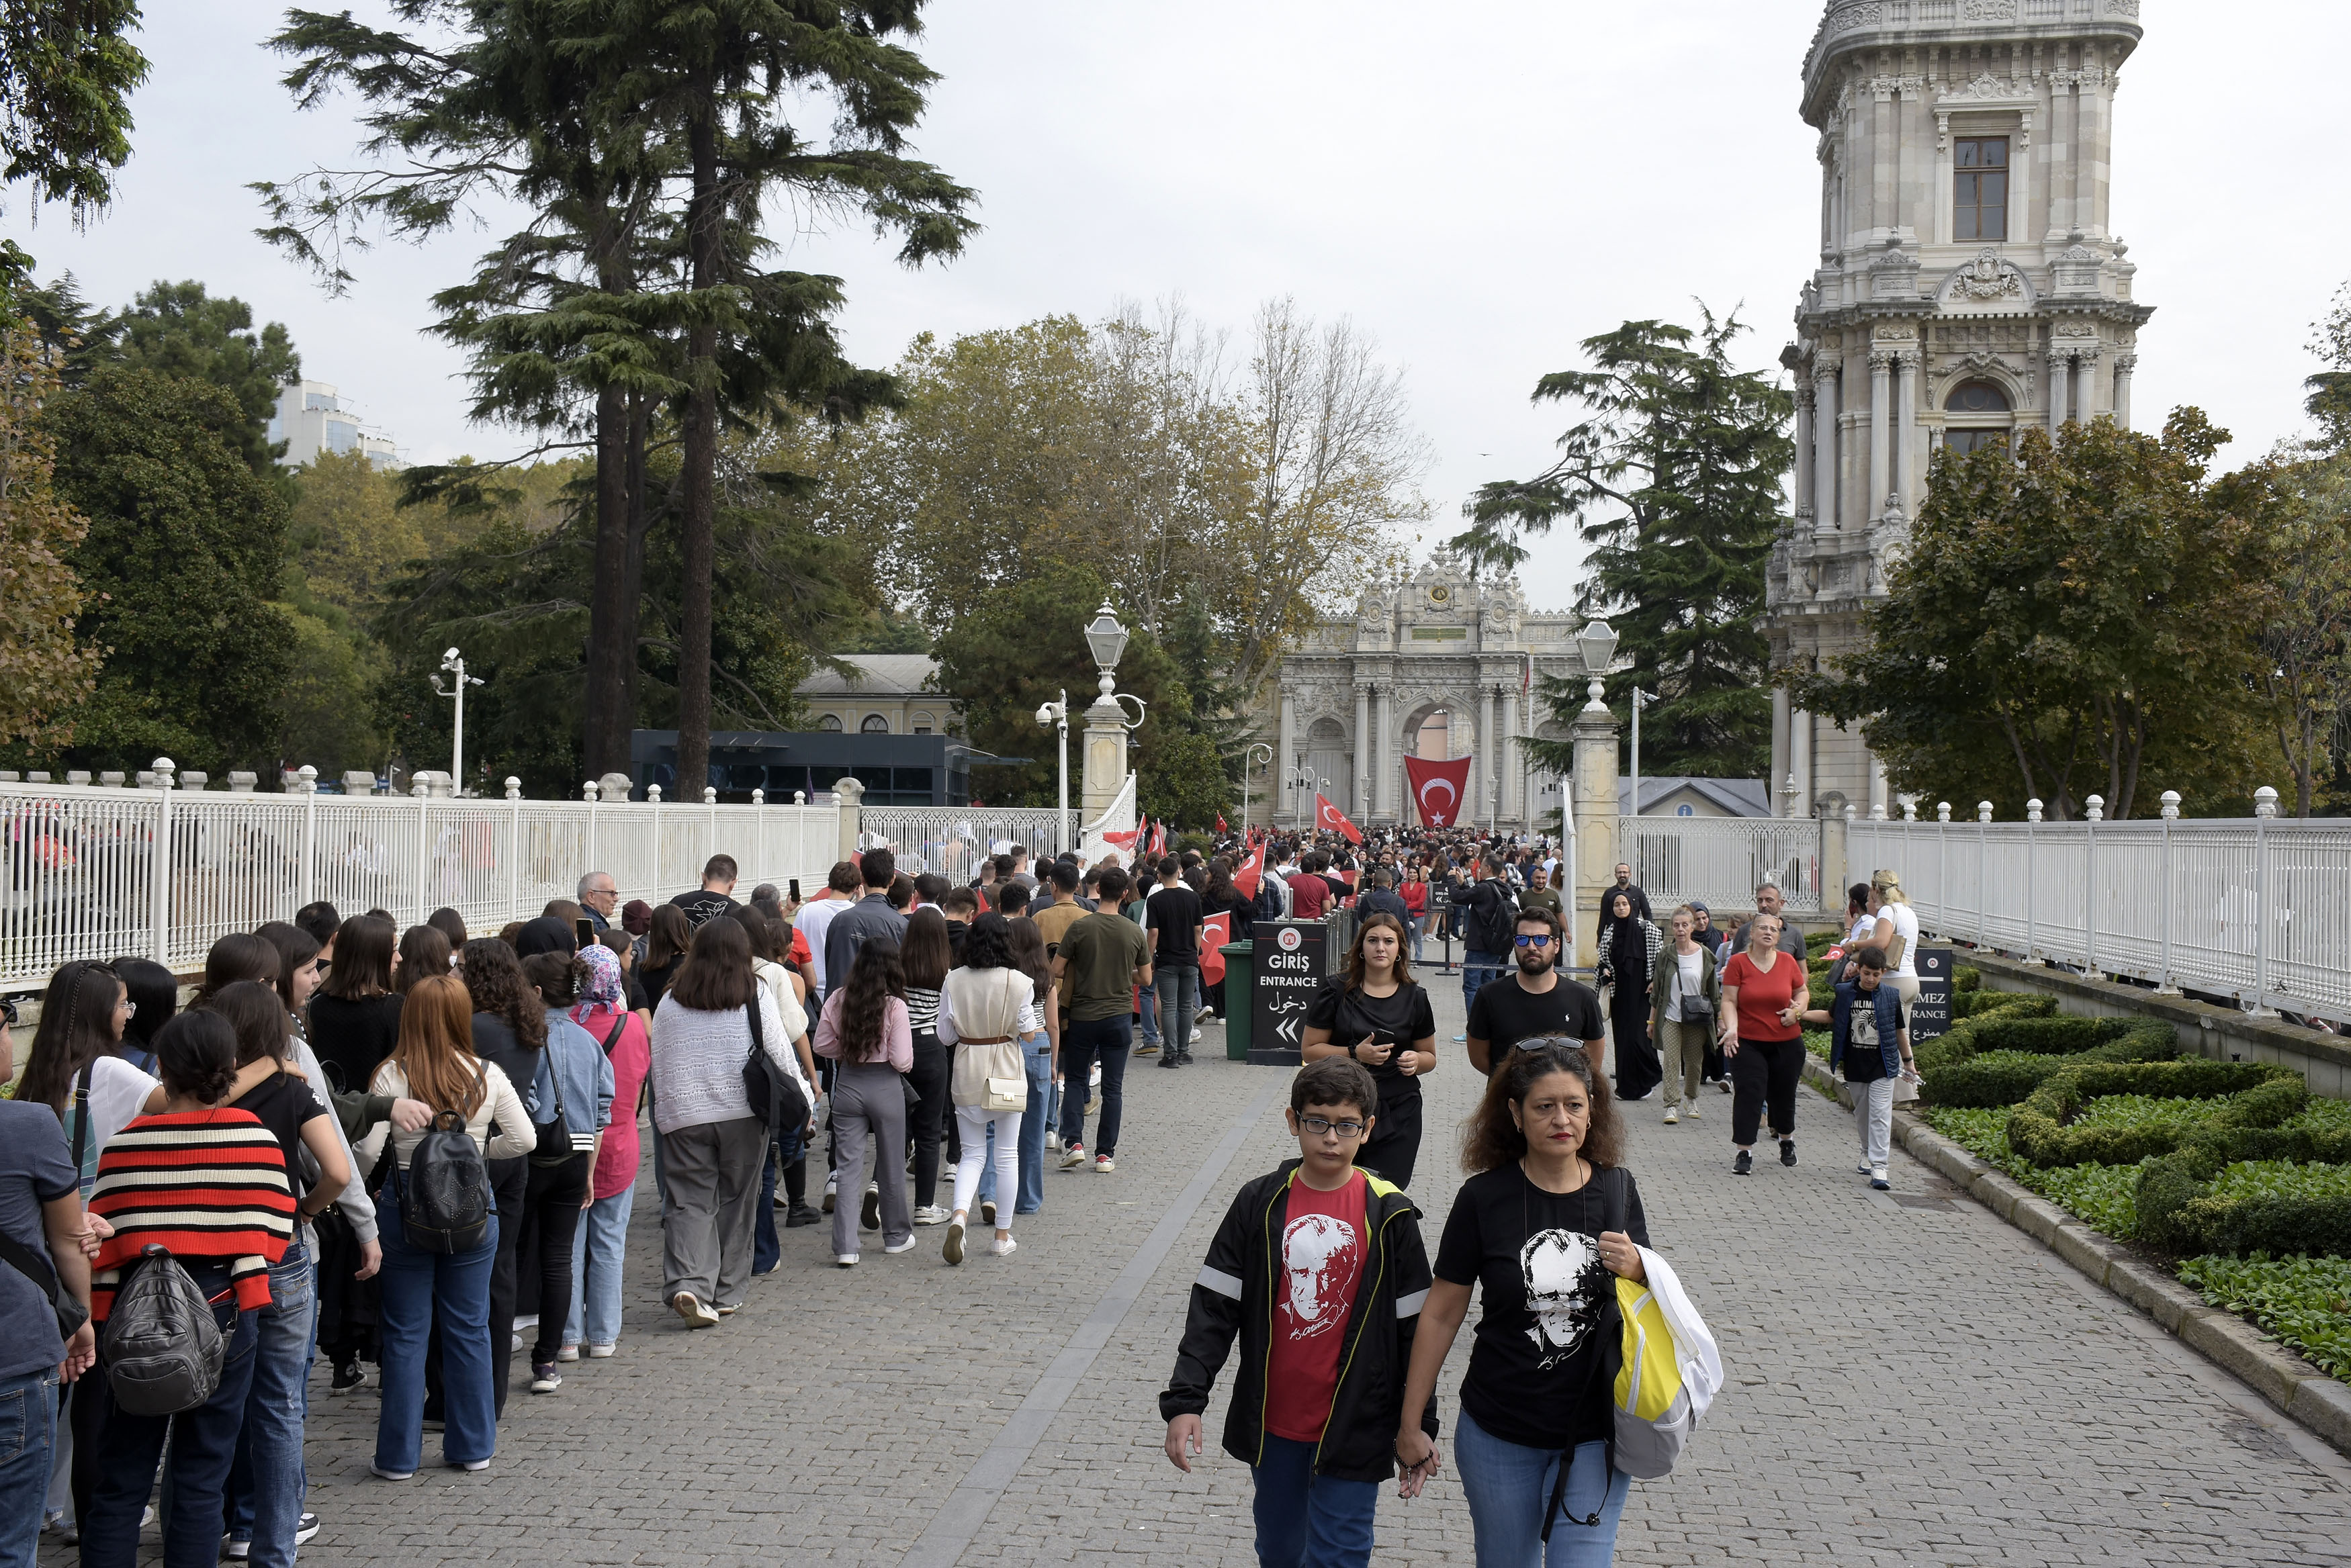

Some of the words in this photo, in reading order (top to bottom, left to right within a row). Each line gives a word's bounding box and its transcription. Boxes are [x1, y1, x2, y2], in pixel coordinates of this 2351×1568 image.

[1268, 952, 1310, 972] GİRİŞ
[1260, 976, 1317, 987] ENTRANCE
[1269, 990, 1307, 1014] دخول
[1913, 993, 1945, 1003] MEZ
[1911, 1010, 1947, 1019] RANCE
[1912, 1028, 1941, 1041] ممنوع
